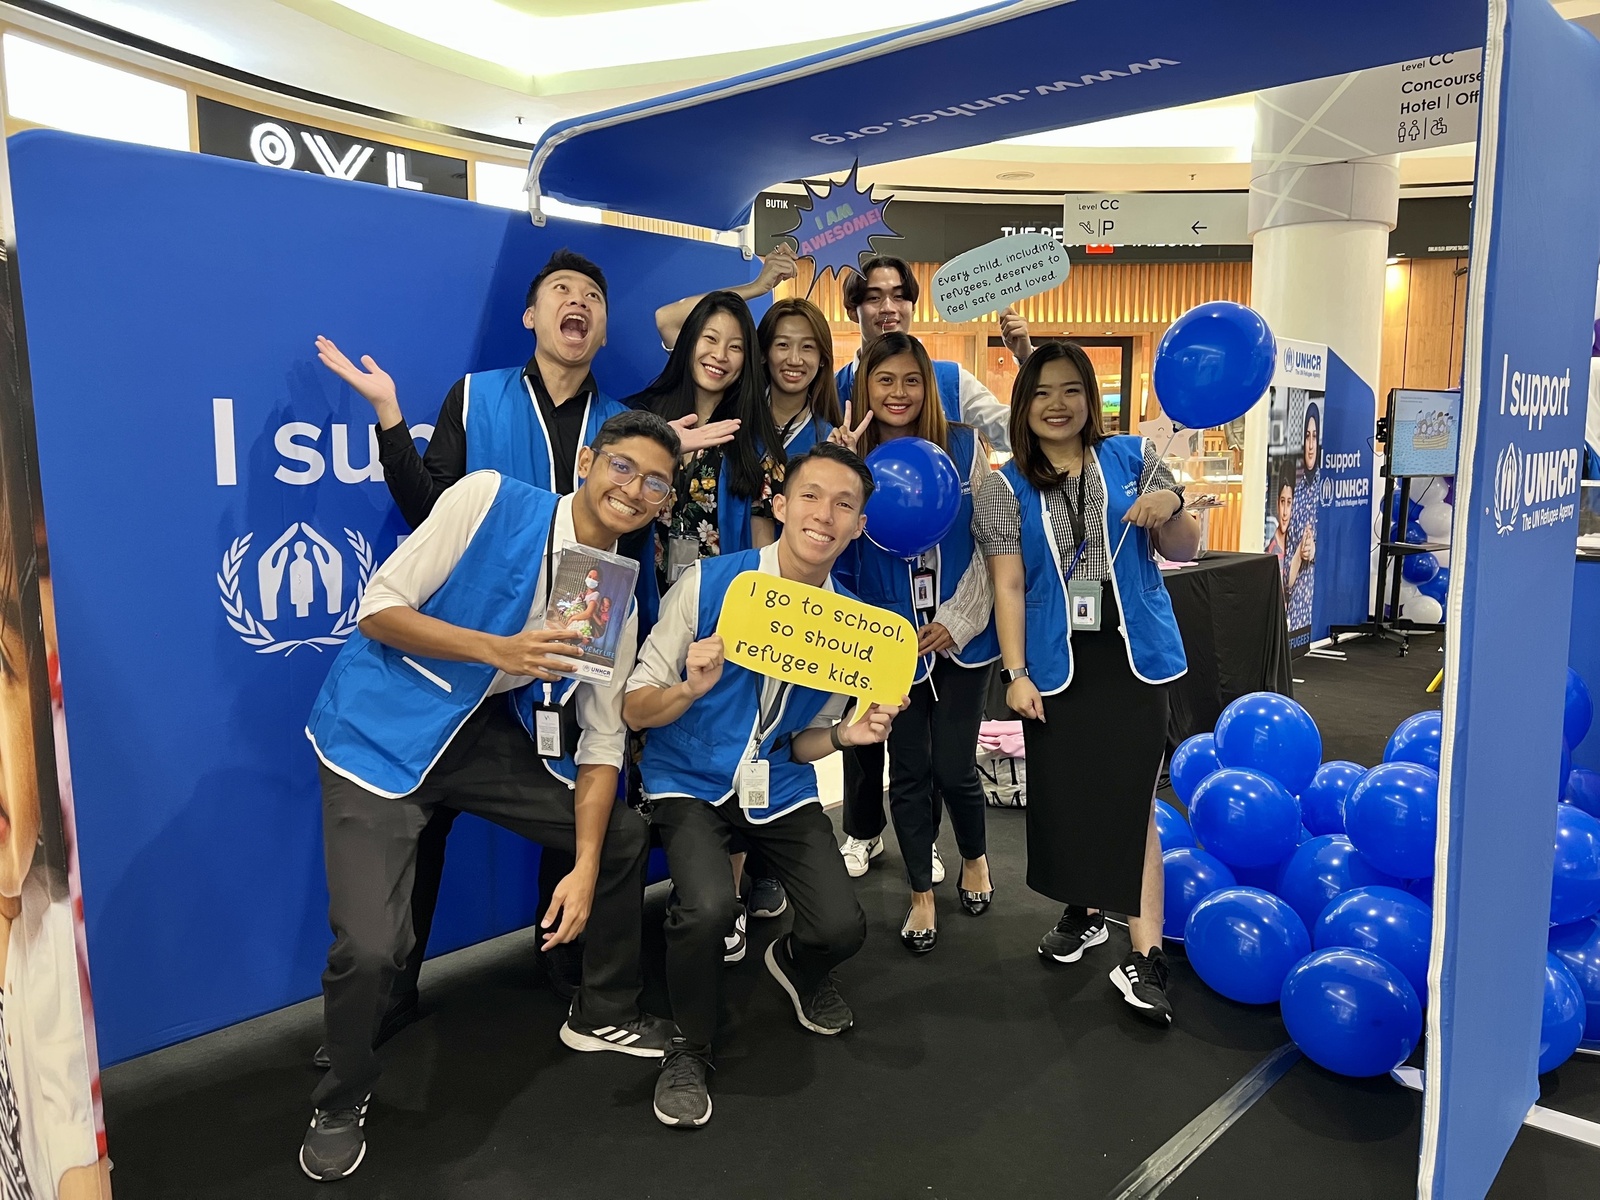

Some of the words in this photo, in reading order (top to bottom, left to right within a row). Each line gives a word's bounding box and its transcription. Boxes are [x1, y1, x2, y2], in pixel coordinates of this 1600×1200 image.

[1401, 61, 1425, 71] Level
[1429, 52, 1454, 66] CC
[810, 57, 1182, 145] www.unhcr.org
[1400, 96, 1441, 115] Hotel
[765, 199, 789, 209] BUTIK
[814, 216, 824, 230] I
[826, 203, 854, 226] AM
[1078, 203, 1098, 211] Level
[1100, 199, 1120, 210] CC
[801, 208, 882, 255] AWESOME!
[1102, 220, 1114, 236] P
[937, 270, 970, 287] Every
[1006, 241, 1056, 263] including
[940, 279, 992, 302] refugees,
[995, 260, 1044, 283] deserves
[1049, 255, 1060, 265] to
[946, 300, 968, 315] feel
[972, 292, 996, 306] safe
[1000, 282, 1022, 296] and
[1025, 270, 1058, 288] loved.
[1295, 351, 1322, 371] UNHCR
[1500, 354, 1508, 415] I
[1510, 368, 1570, 431] support
[212, 398, 237, 486] I
[1325, 449, 1361, 473] support
[1335, 478, 1369, 499] UNHCR
[1523, 448, 1578, 507] UNHCR
[1522, 513, 1532, 532] The
[1532, 509, 1541, 529] UN
[1540, 507, 1559, 527] Refugee
[1558, 503, 1575, 522] Agency
[750, 582, 756, 597] I
[765, 589, 791, 608] go
[801, 597, 823, 615] to
[834, 609, 905, 643] school,
[593, 648, 603, 656] MY
[603, 650, 615, 658] LIFE
[770, 620, 794, 637] so
[804, 630, 874, 662] should
[591, 667, 611, 676] UNHCR
[736, 640, 819, 673] refugee
[828, 663, 873, 691] kids.
